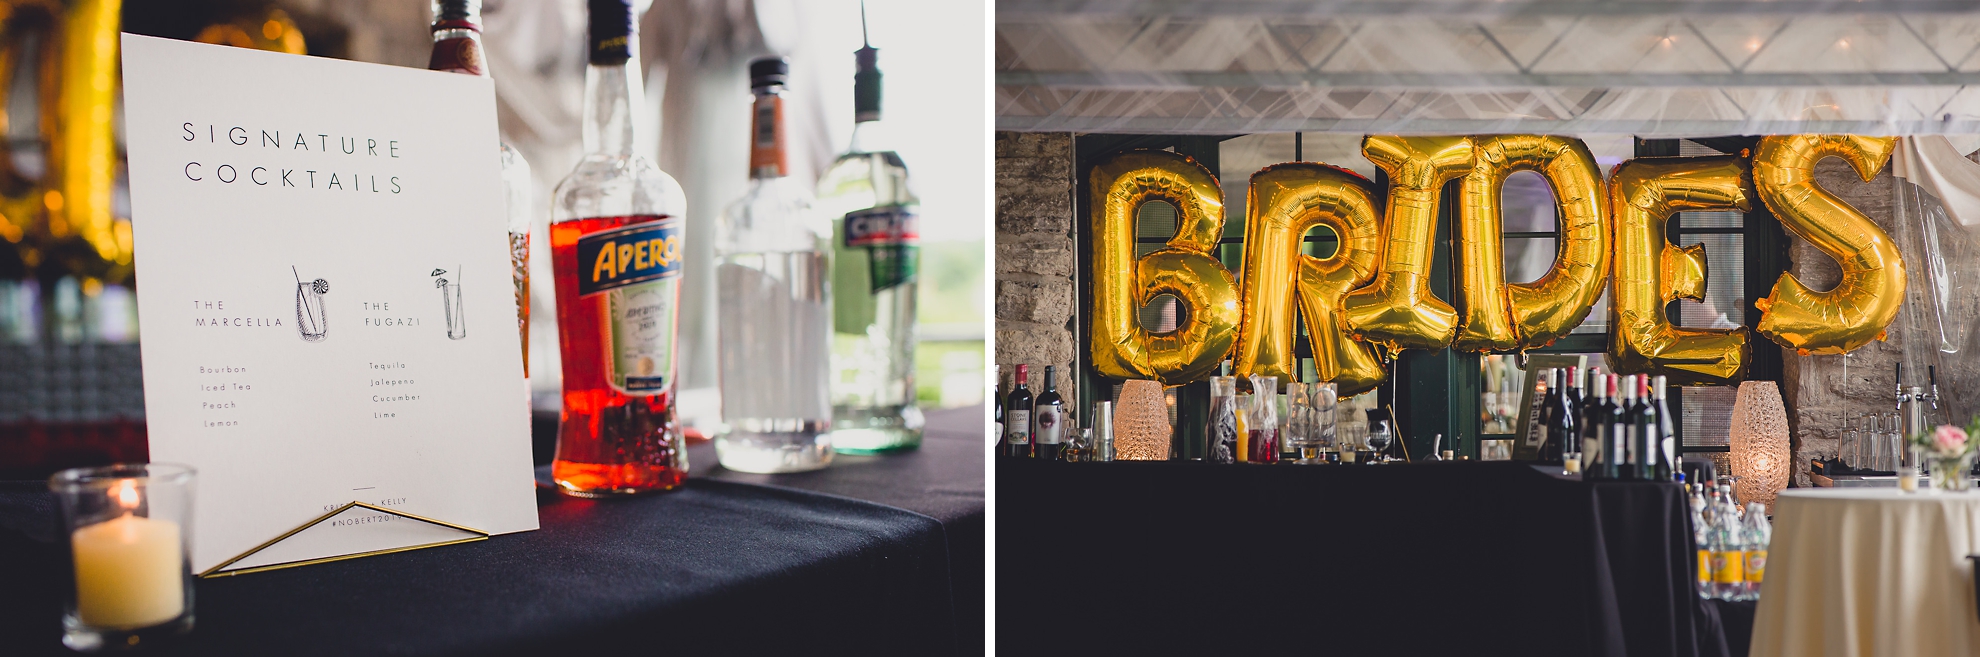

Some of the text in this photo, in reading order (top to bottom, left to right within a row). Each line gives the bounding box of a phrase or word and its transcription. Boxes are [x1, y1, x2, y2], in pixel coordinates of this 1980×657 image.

[182, 121, 400, 159] SIGNATURE
[184, 161, 402, 195] COCKTAILS
[1090, 134, 1907, 396] BRIDES
[194, 300, 224, 311] THE
[363, 302, 389, 311] THE
[195, 317, 283, 327] MARCELLA
[365, 317, 421, 327] FUGAZI
[199, 365, 246, 374] Bourbon
[368, 361, 406, 371] Tequila
[201, 382, 251, 392] Iced Tea
[370, 378, 415, 388] Jalepeno
[372, 393, 421, 403] Cucumber
[202, 400, 236, 410] Peach
[374, 411, 396, 419] Lime
[204, 420, 239, 428] Lemon
[381, 497, 406, 506] KELLY
